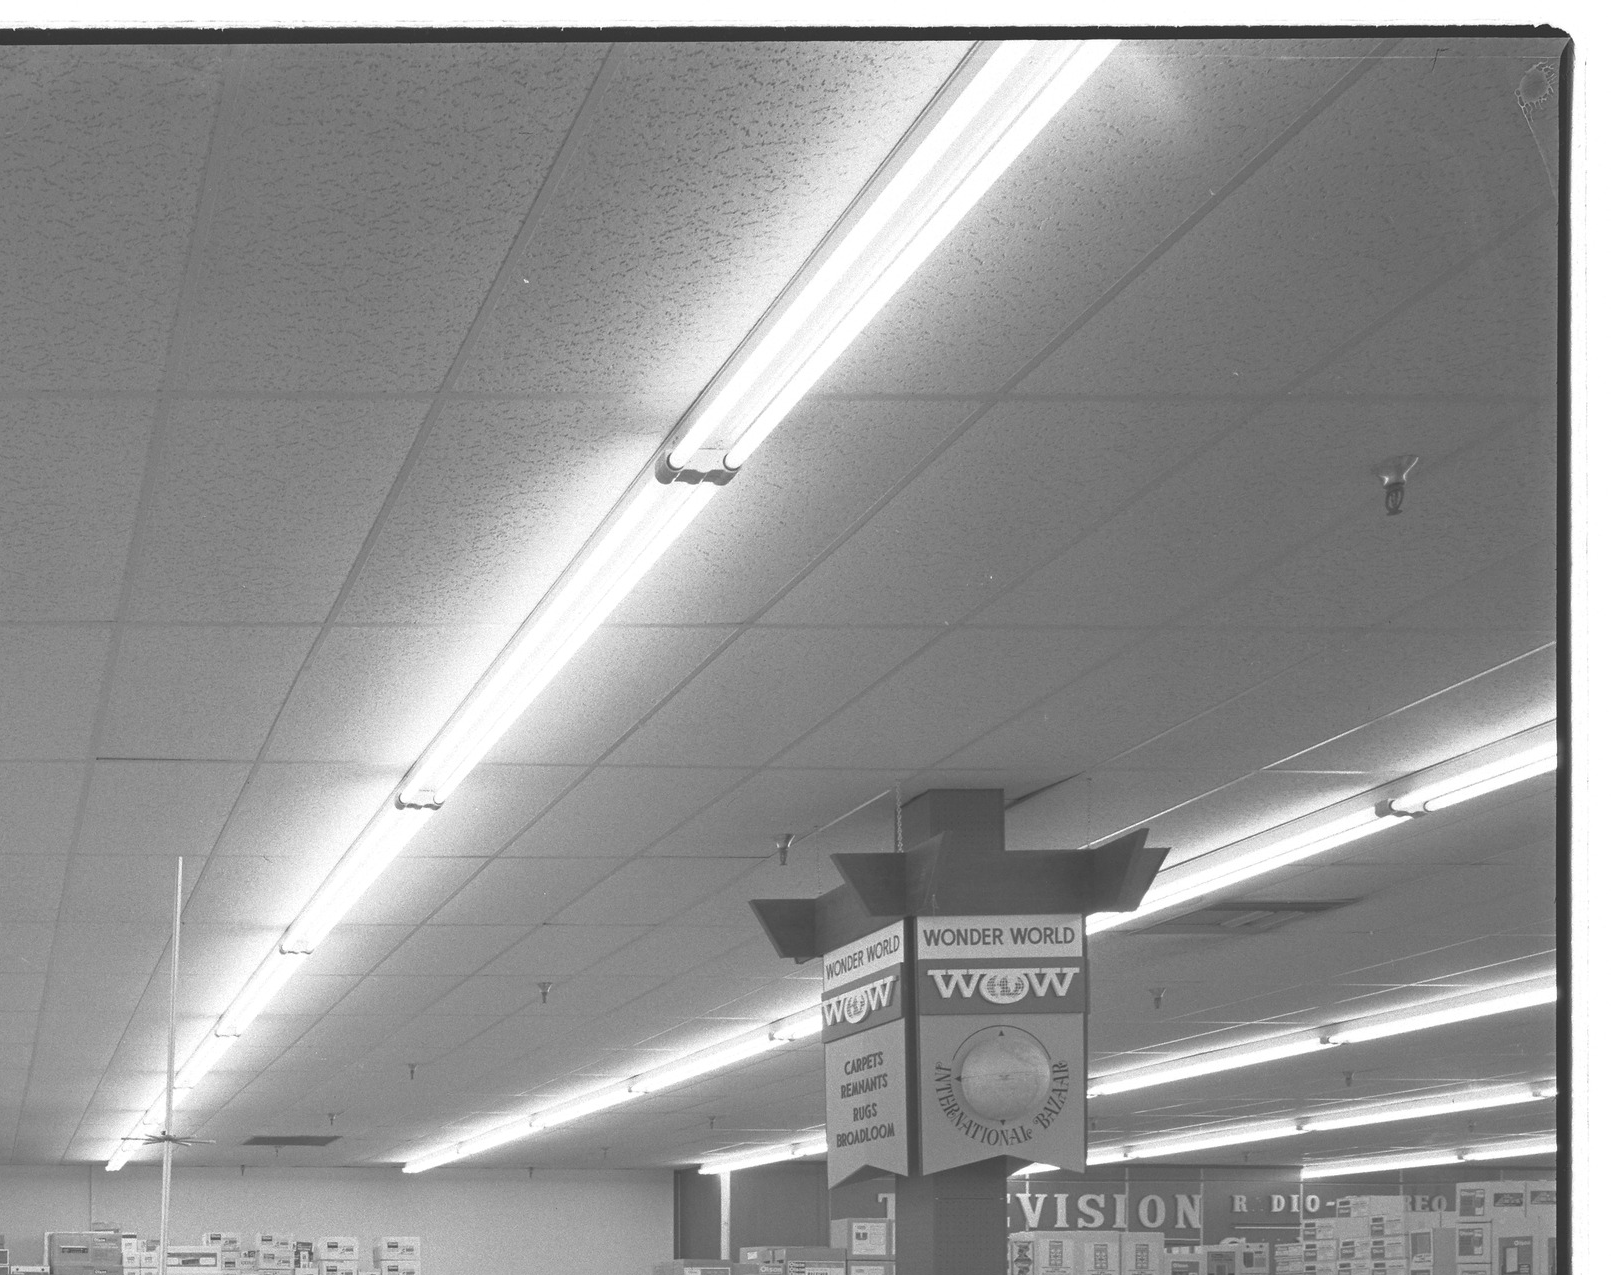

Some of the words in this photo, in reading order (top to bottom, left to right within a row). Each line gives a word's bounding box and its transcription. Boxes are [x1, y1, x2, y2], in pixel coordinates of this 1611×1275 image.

[923, 928, 1004, 947] WONDER
[1010, 926, 1076, 945] WORLD
[825, 947, 864, 981] WONDER
[866, 934, 901, 963] WORLD
[844, 1051, 884, 1076] CARPETS
[840, 1073, 889, 1099] REMNANTS
[852, 1102, 878, 1122] RUGS
[934, 1061, 1033, 1146] INTERNATIONAL
[1033, 1060, 1070, 1130] BAZAAR
[836, 1122, 896, 1149] BROADLOOM
